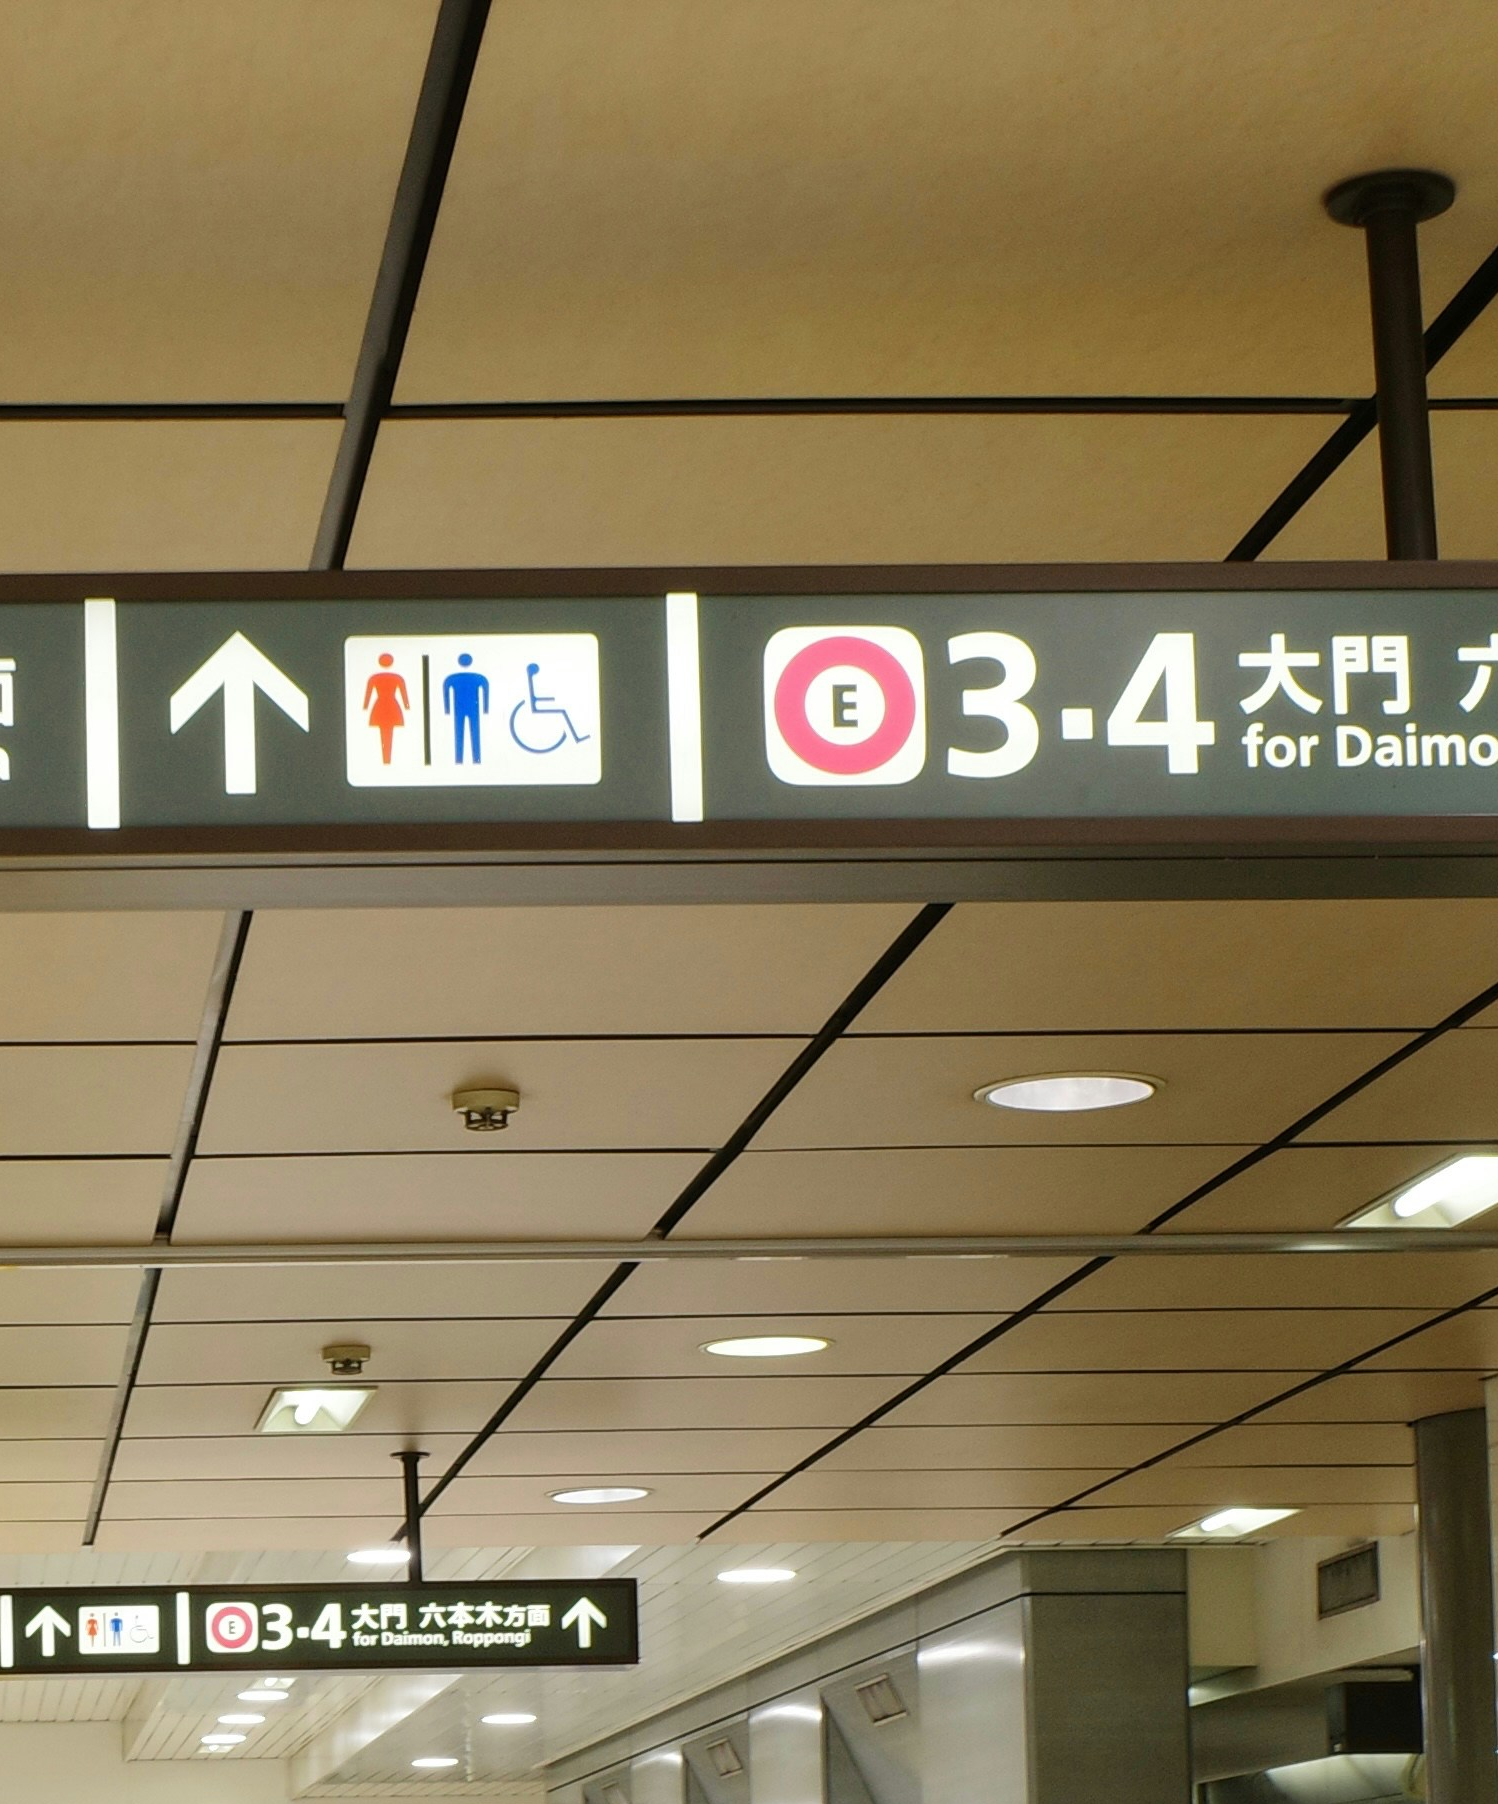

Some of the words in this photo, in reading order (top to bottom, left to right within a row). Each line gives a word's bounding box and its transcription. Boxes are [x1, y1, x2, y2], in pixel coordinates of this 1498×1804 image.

[1239, 634, 1410, 714] 大門
[833, 685, 858, 727] E
[1242, 723, 1314, 767] for
[229, 1621, 235, 1634] E
[351, 1603, 407, 1629] 大門
[419, 1602, 550, 1630] 六本木方面
[352, 1631, 379, 1646] for
[381, 1631, 449, 1646] Daimon,
[452, 1629, 531, 1647] Roppongi
